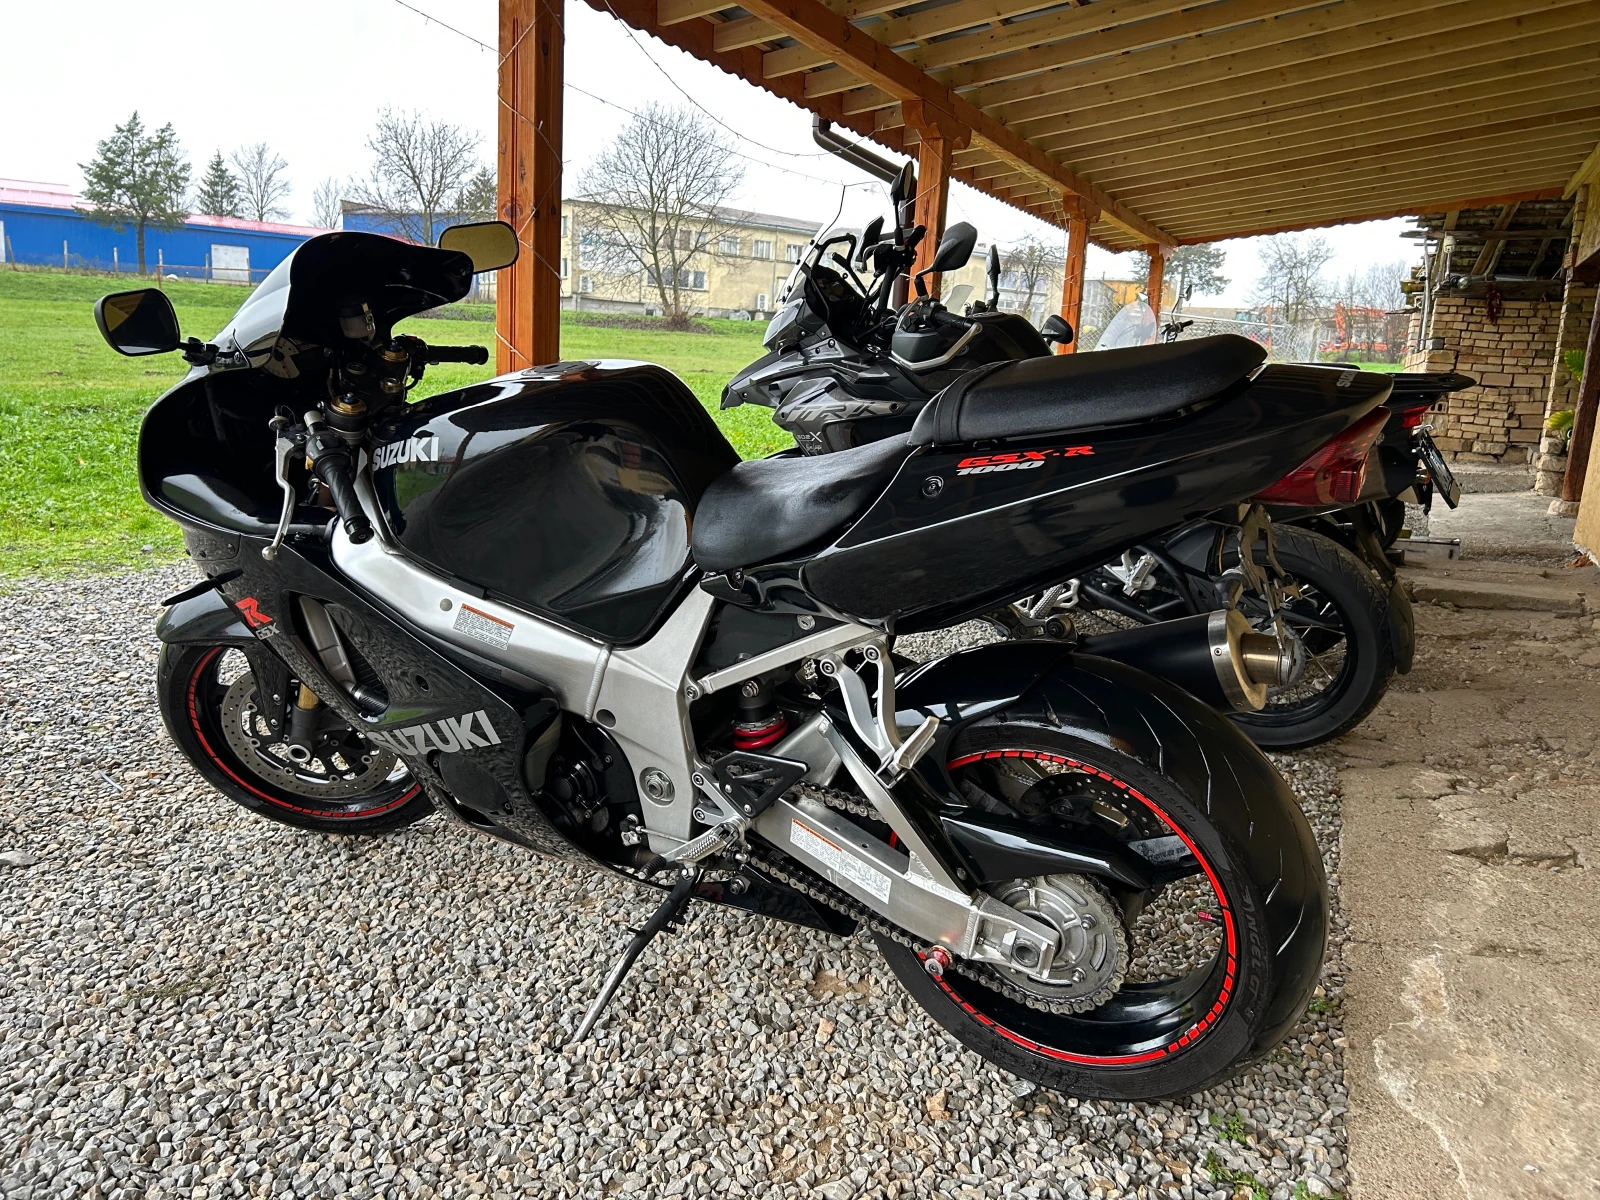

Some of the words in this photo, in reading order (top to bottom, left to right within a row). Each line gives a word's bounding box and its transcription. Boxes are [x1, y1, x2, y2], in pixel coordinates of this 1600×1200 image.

[372, 436, 439, 472] SUZUKI
[957, 445, 1096, 468] GSX-R
[956, 460, 1045, 476] 1000
[256, 622, 280, 640] GSX
[366, 709, 501, 756] SUZUKI
